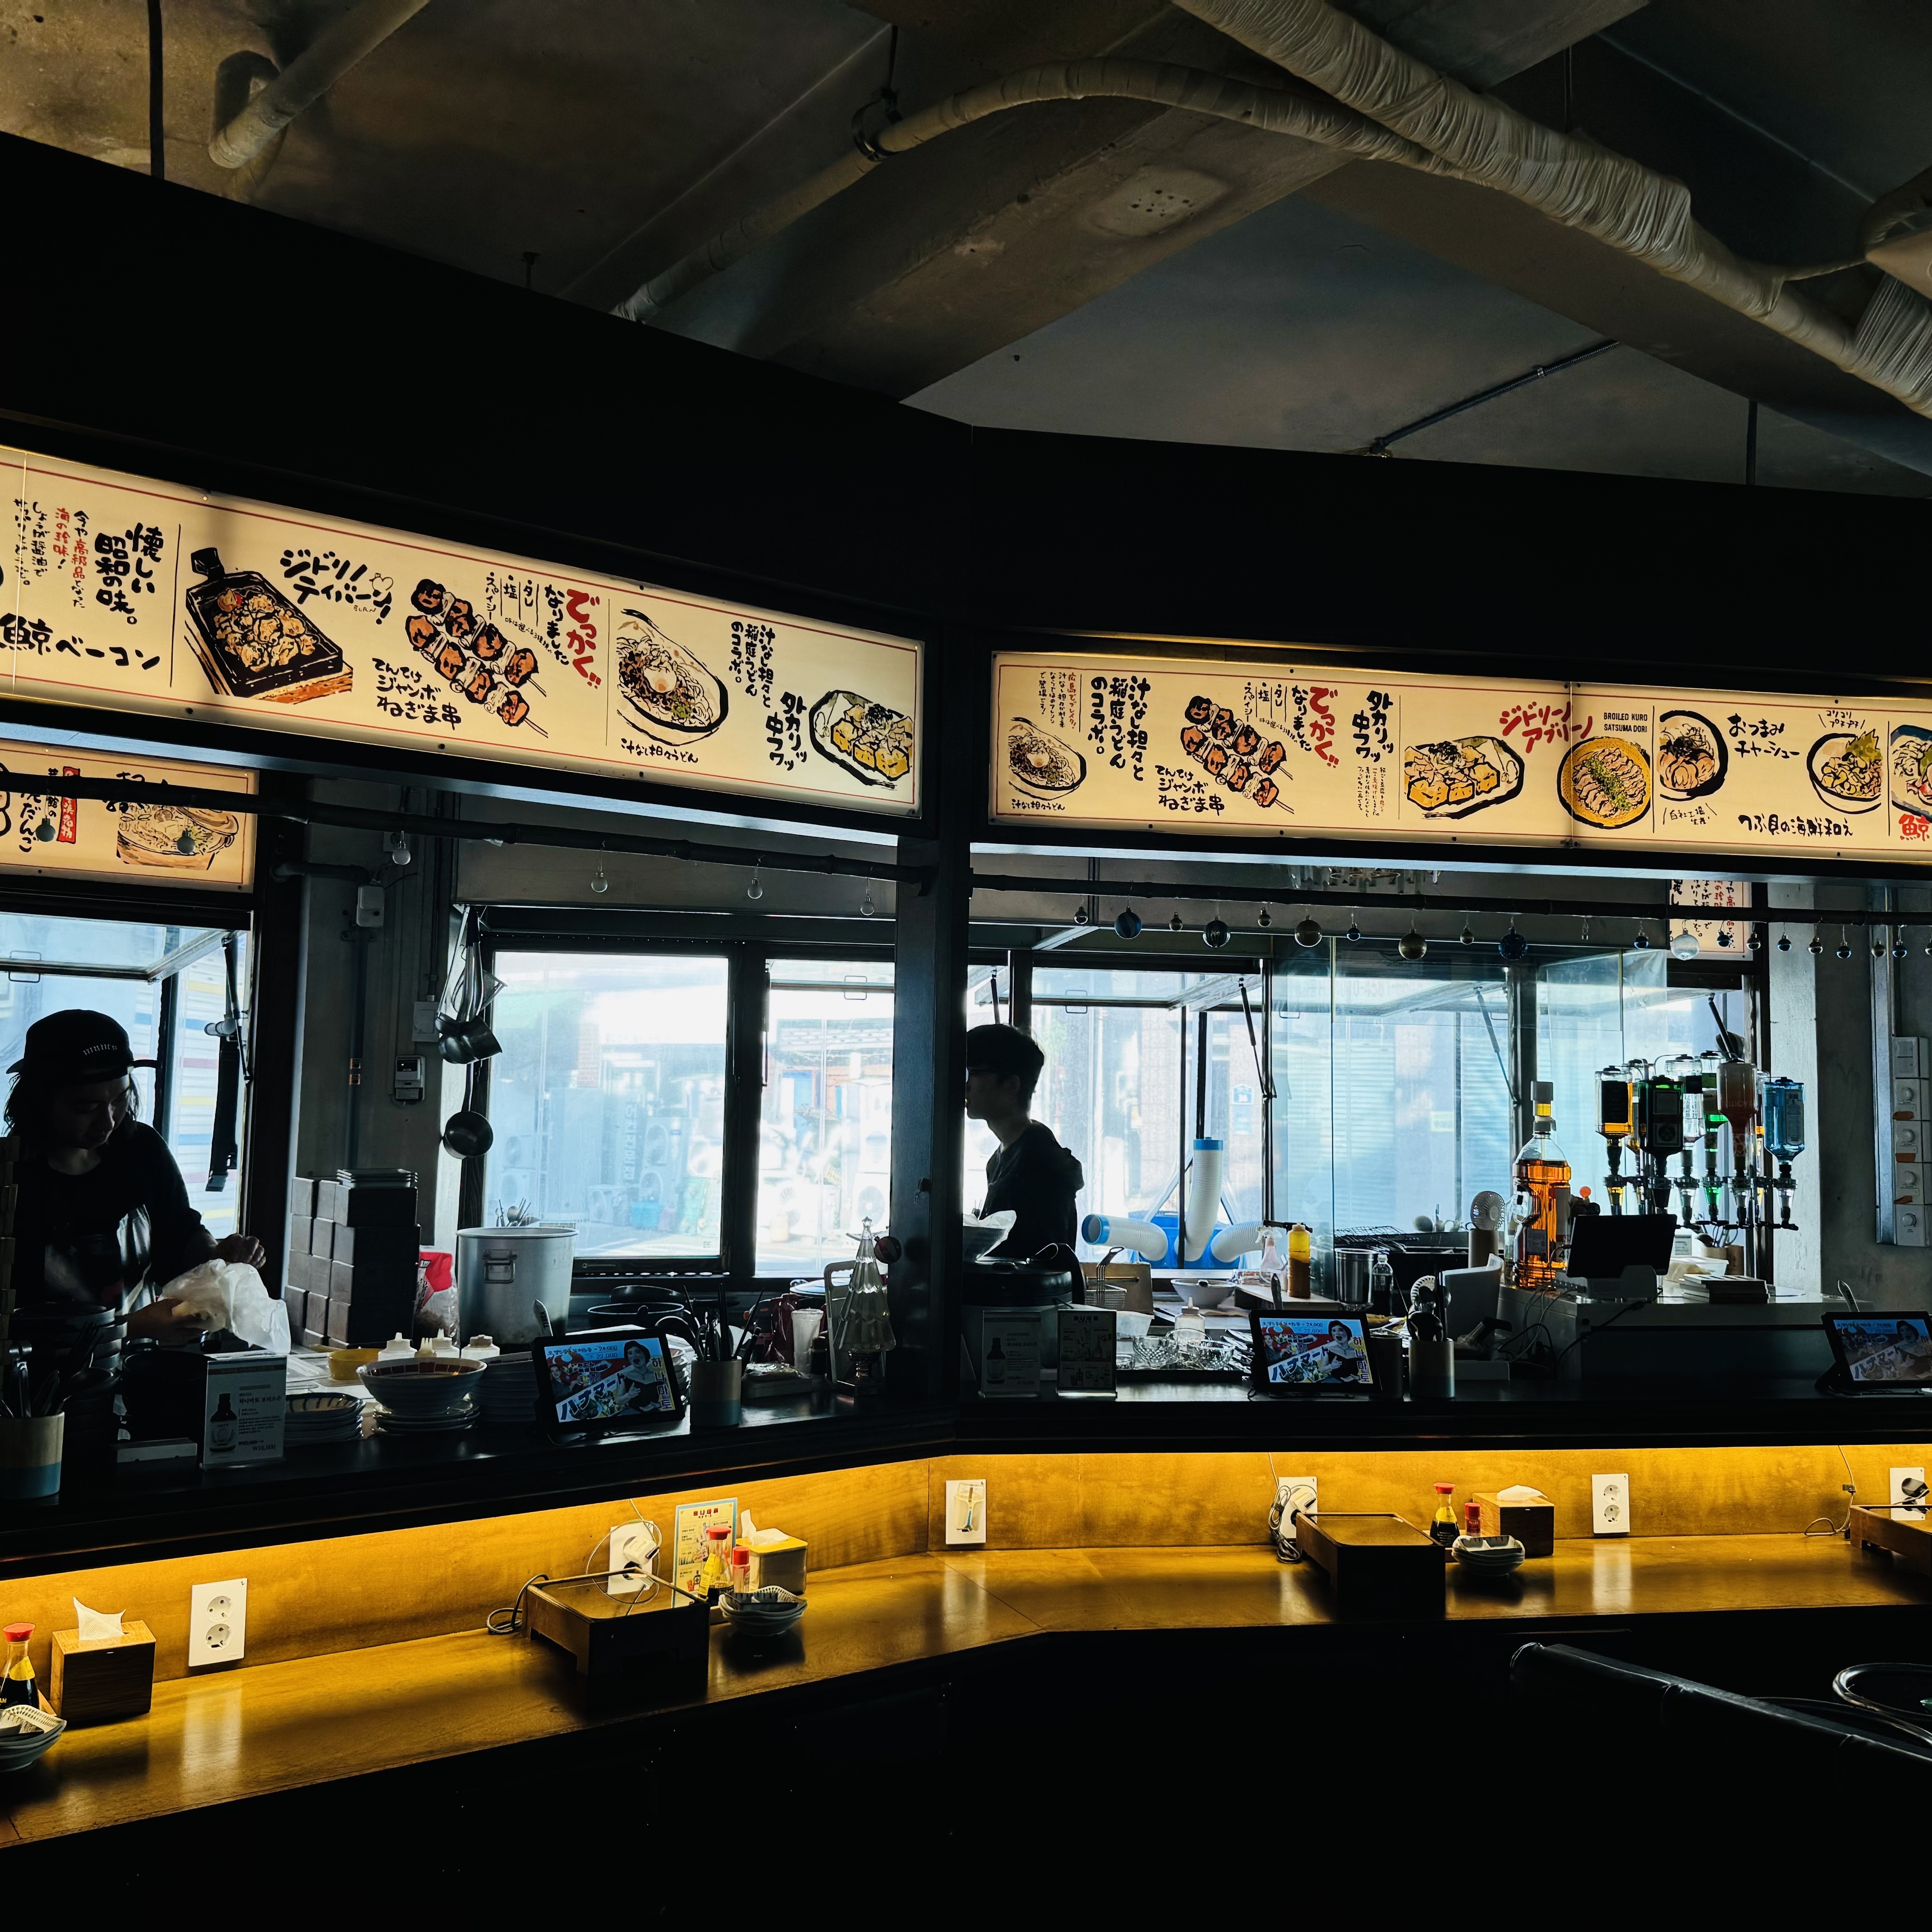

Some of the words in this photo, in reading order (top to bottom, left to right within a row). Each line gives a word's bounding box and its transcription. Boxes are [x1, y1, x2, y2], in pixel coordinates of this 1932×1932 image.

[95, 533, 137, 625] 昭和の味。
[126, 523, 163, 593] 懐しい
[544, 584, 569, 665] なりました
[377, 676, 442, 701] ジャンボ
[745, 624, 759, 697] 稲庭うどん
[376, 695, 461, 730] ねぎま串
[779, 691, 807, 764] 外カリッ
[1088, 676, 1108, 754] のコラボ。
[1109, 677, 1128, 769] 稲庭うどん
[1127, 675, 1151, 781] 汁なし担々と
[1292, 685, 1312, 751] なりました
[1352, 709, 1380, 763] 中フワッ
[1366, 690, 1394, 754] 外カリッ
[1499, 701, 1572, 737] ジドリーノ
[1603, 712, 1629, 721] BROILED
[1631, 713, 1648, 722] KURO
[1604, 723, 1632, 733] SATSUMA
[1633, 724, 1647, 733] DORI
[1727, 713, 1785, 738] おつまみ
[765, 712, 794, 771] 中フワッ
[1734, 740, 1801, 759] チャーシュー
[1157, 777, 1209, 795] ジャンボ
[1158, 793, 1225, 816] ねぎま串
[560, 1372, 626, 1421] ハナマート
